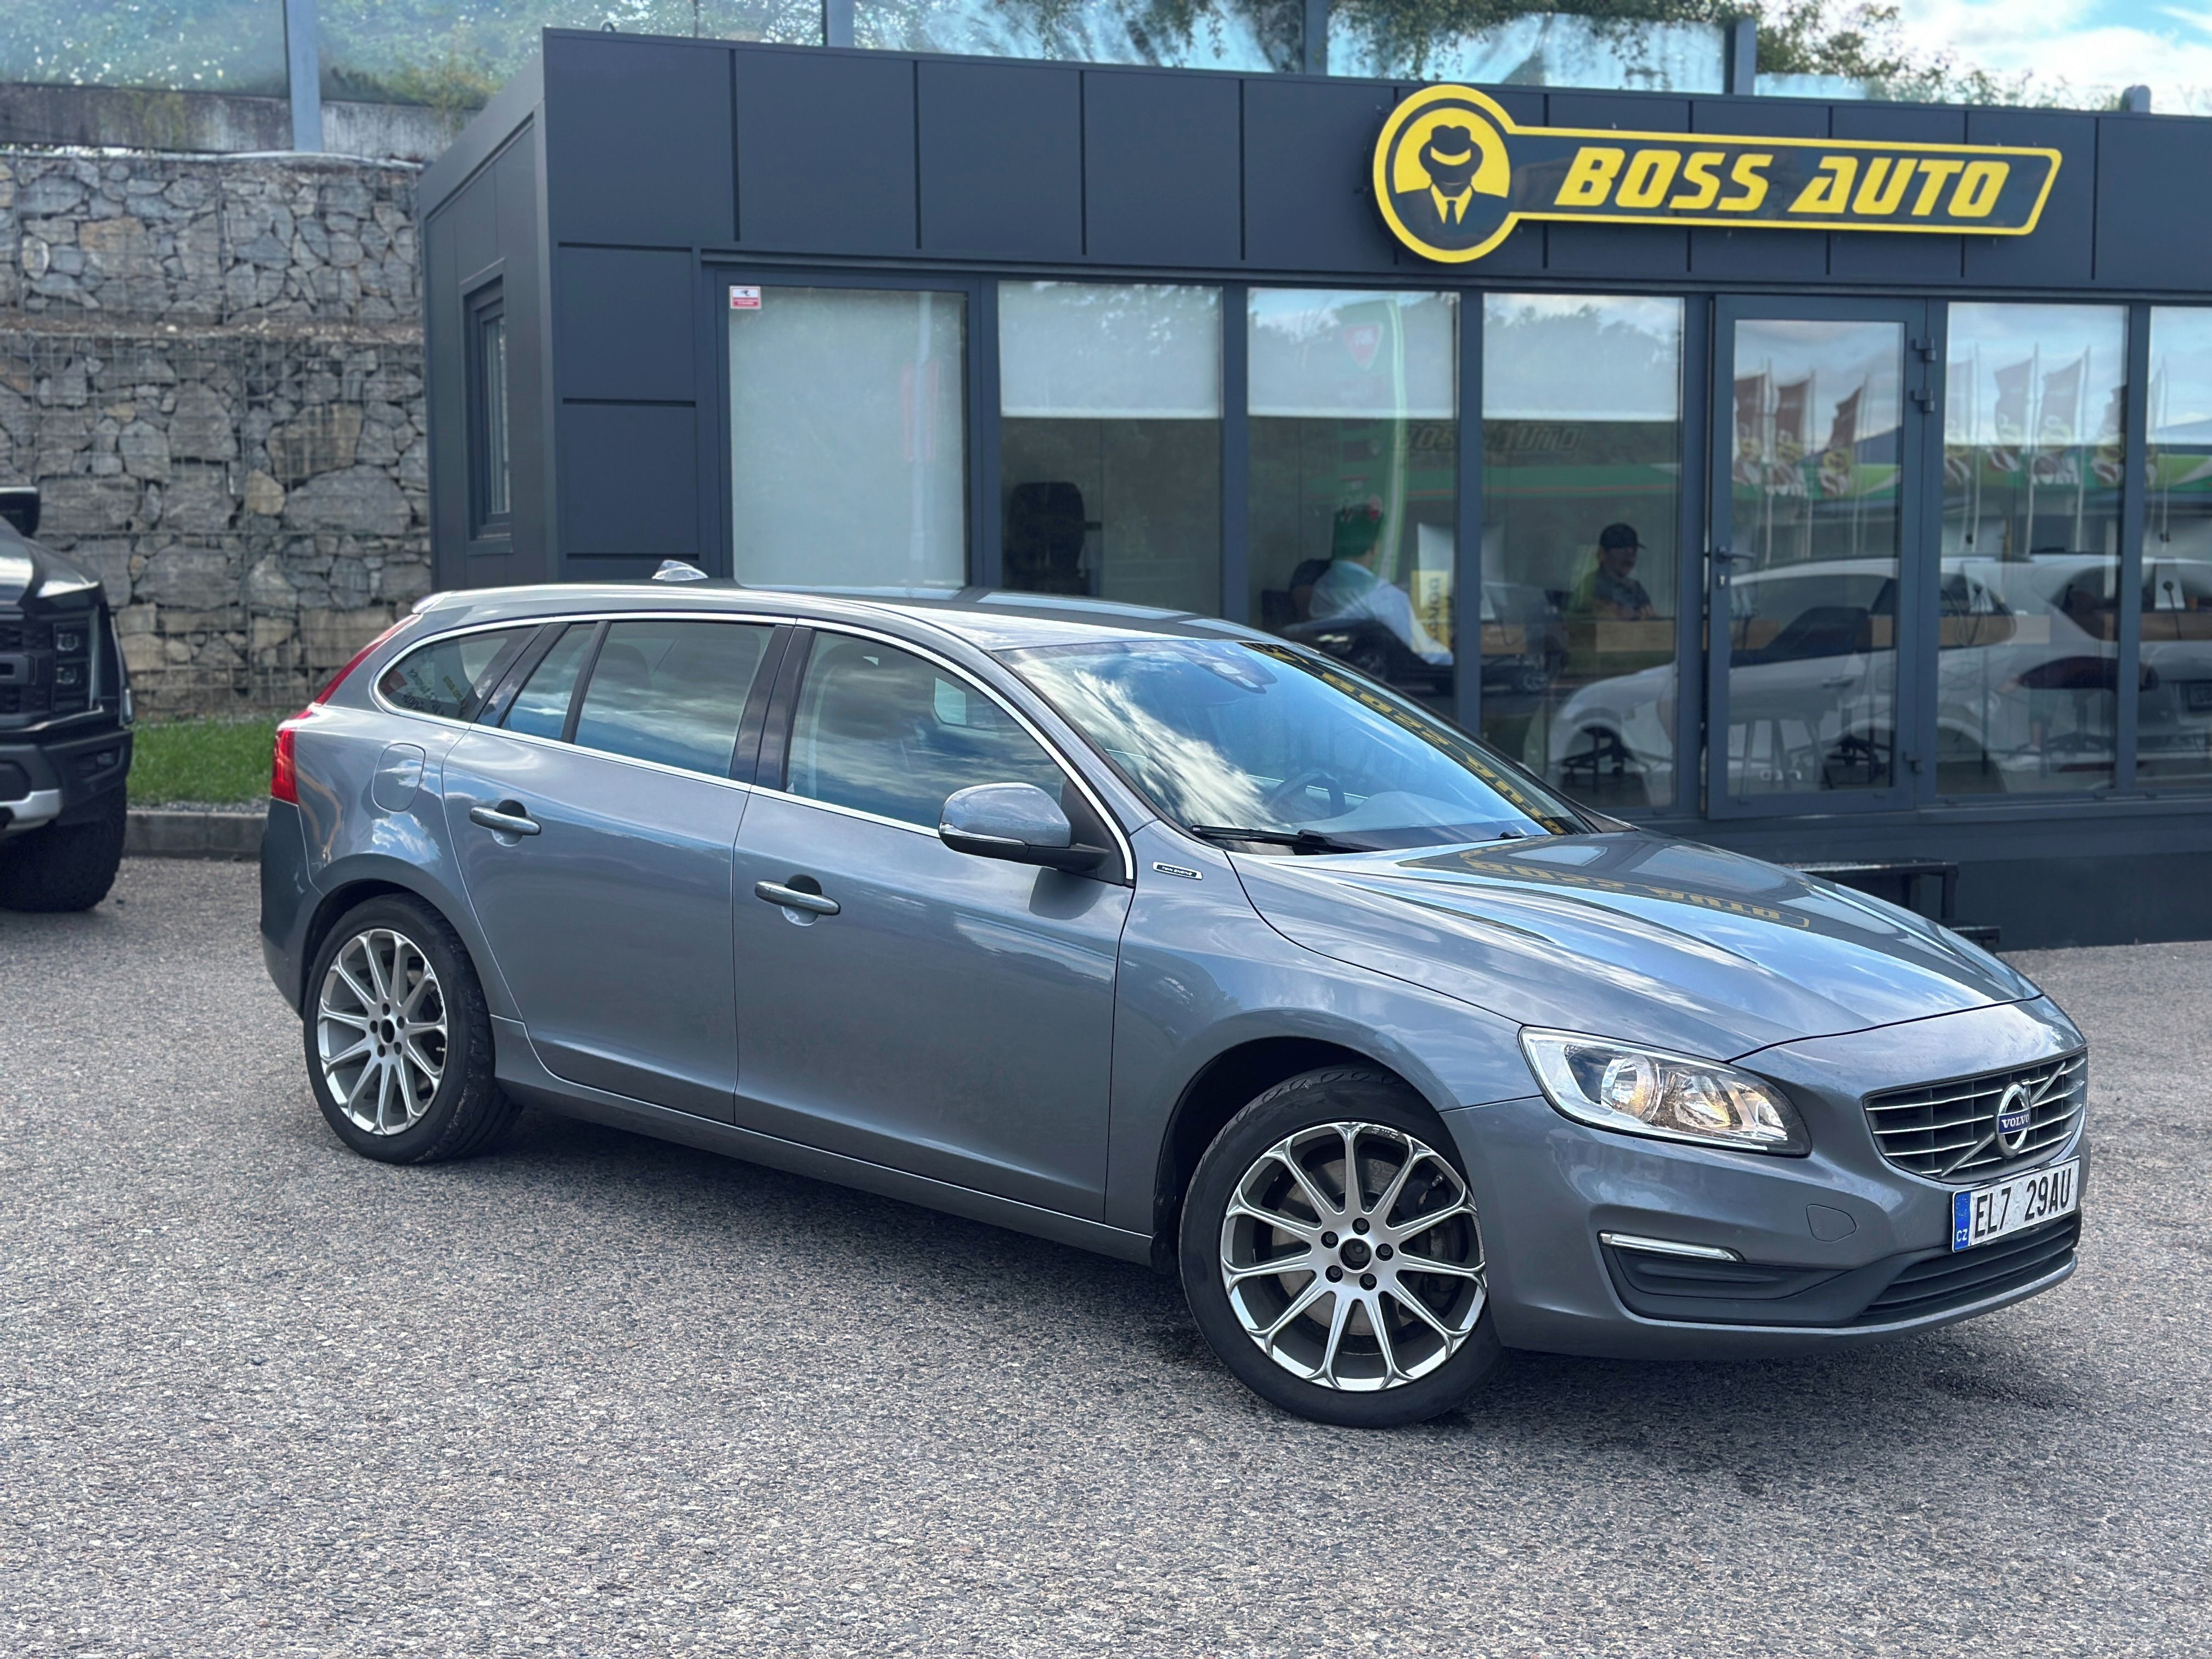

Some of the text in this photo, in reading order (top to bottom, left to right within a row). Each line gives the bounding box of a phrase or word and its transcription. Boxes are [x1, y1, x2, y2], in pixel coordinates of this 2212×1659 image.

[1554, 146, 2010, 218] BOSS AUTO
[2001, 1114, 2029, 1128] VOLVO
[1974, 1167, 2072, 1238] EL7 29AU
[1956, 1228, 1968, 1243] CZ
